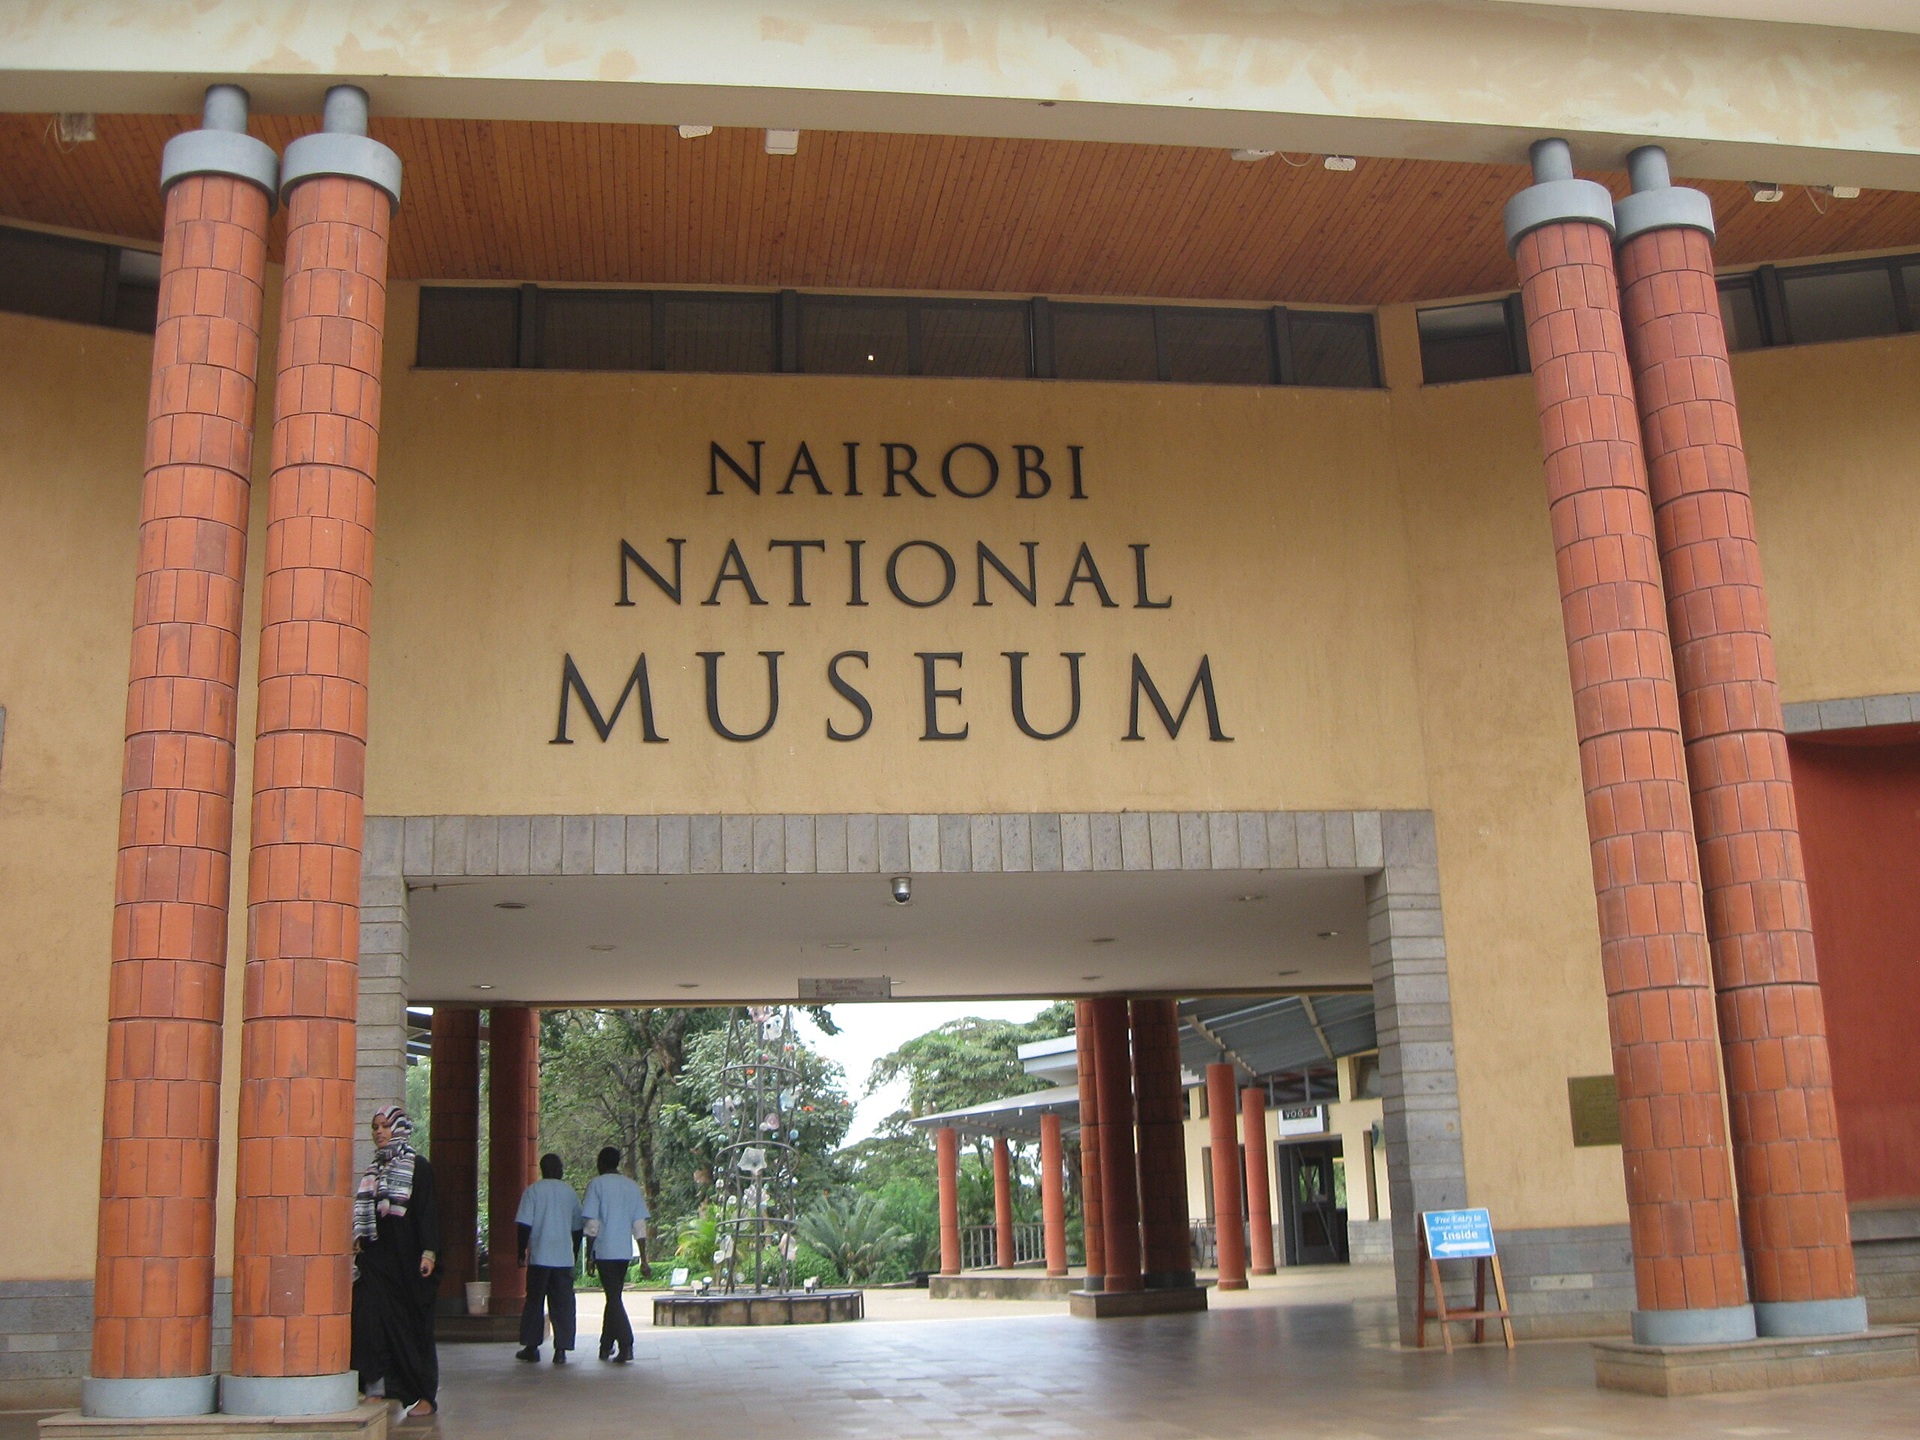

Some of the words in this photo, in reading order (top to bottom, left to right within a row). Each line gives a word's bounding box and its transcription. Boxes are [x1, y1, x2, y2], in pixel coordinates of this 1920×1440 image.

[706, 441, 1089, 499] NAIROBI
[614, 538, 1173, 609] NATIONAL
[549, 650, 1235, 744] MUSEUM
[1434, 1216, 1450, 1224] Free
[1451, 1214, 1472, 1224] Entry
[1442, 1229, 1479, 1241] Inside
